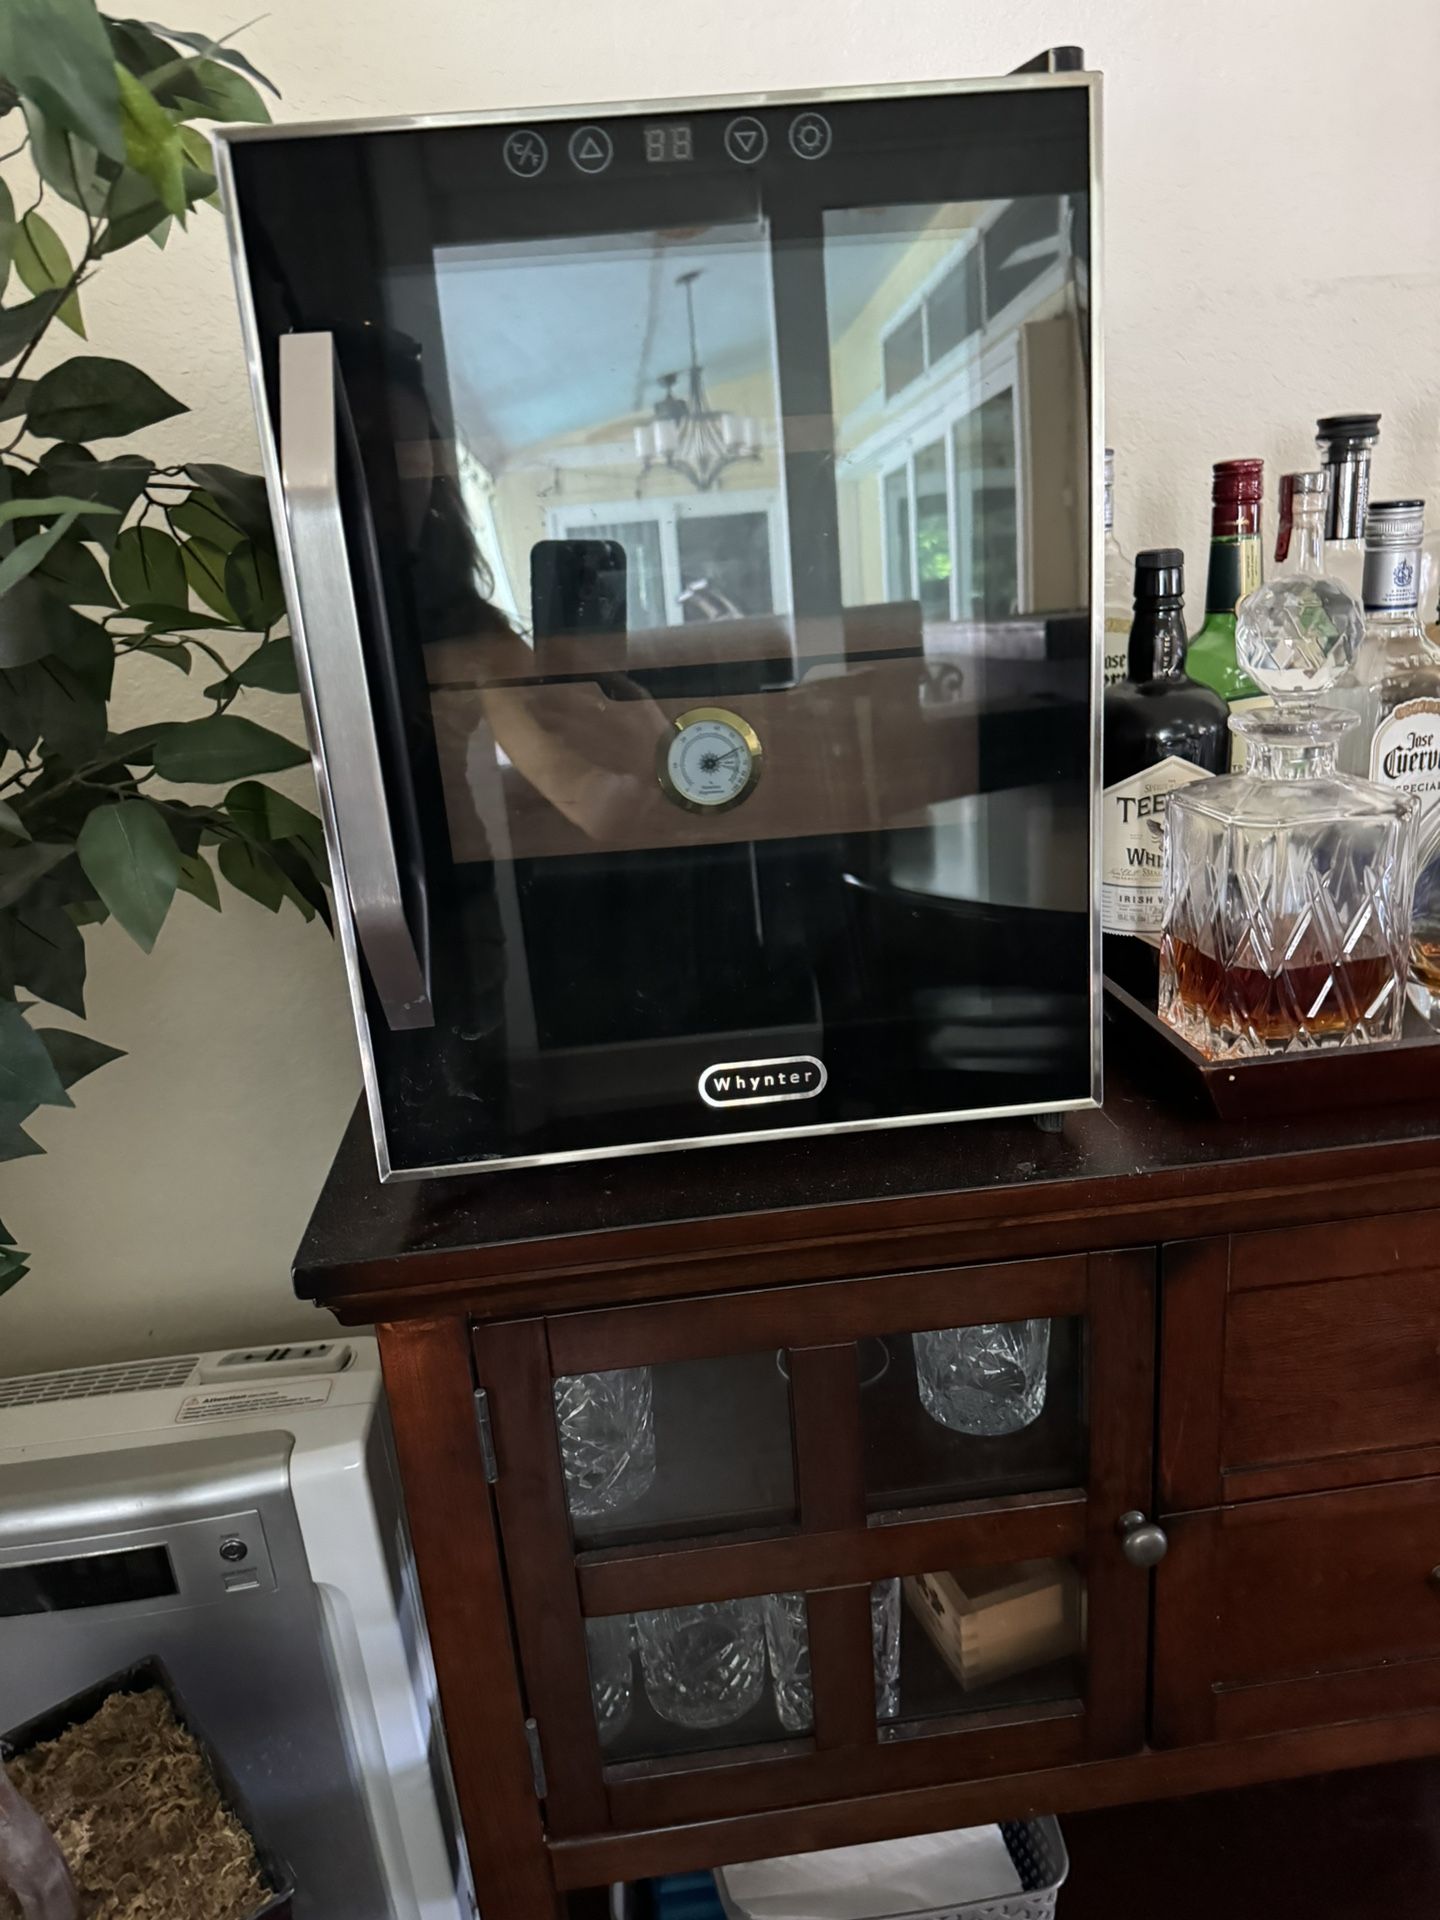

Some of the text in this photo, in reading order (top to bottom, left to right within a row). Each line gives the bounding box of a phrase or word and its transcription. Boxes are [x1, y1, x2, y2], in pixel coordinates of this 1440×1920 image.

[1407, 731, 1434, 752] Jose
[1396, 781, 1440, 793] PECIA
[1119, 895, 1153, 905] IRISH
[713, 1070, 813, 1092] Whynter
